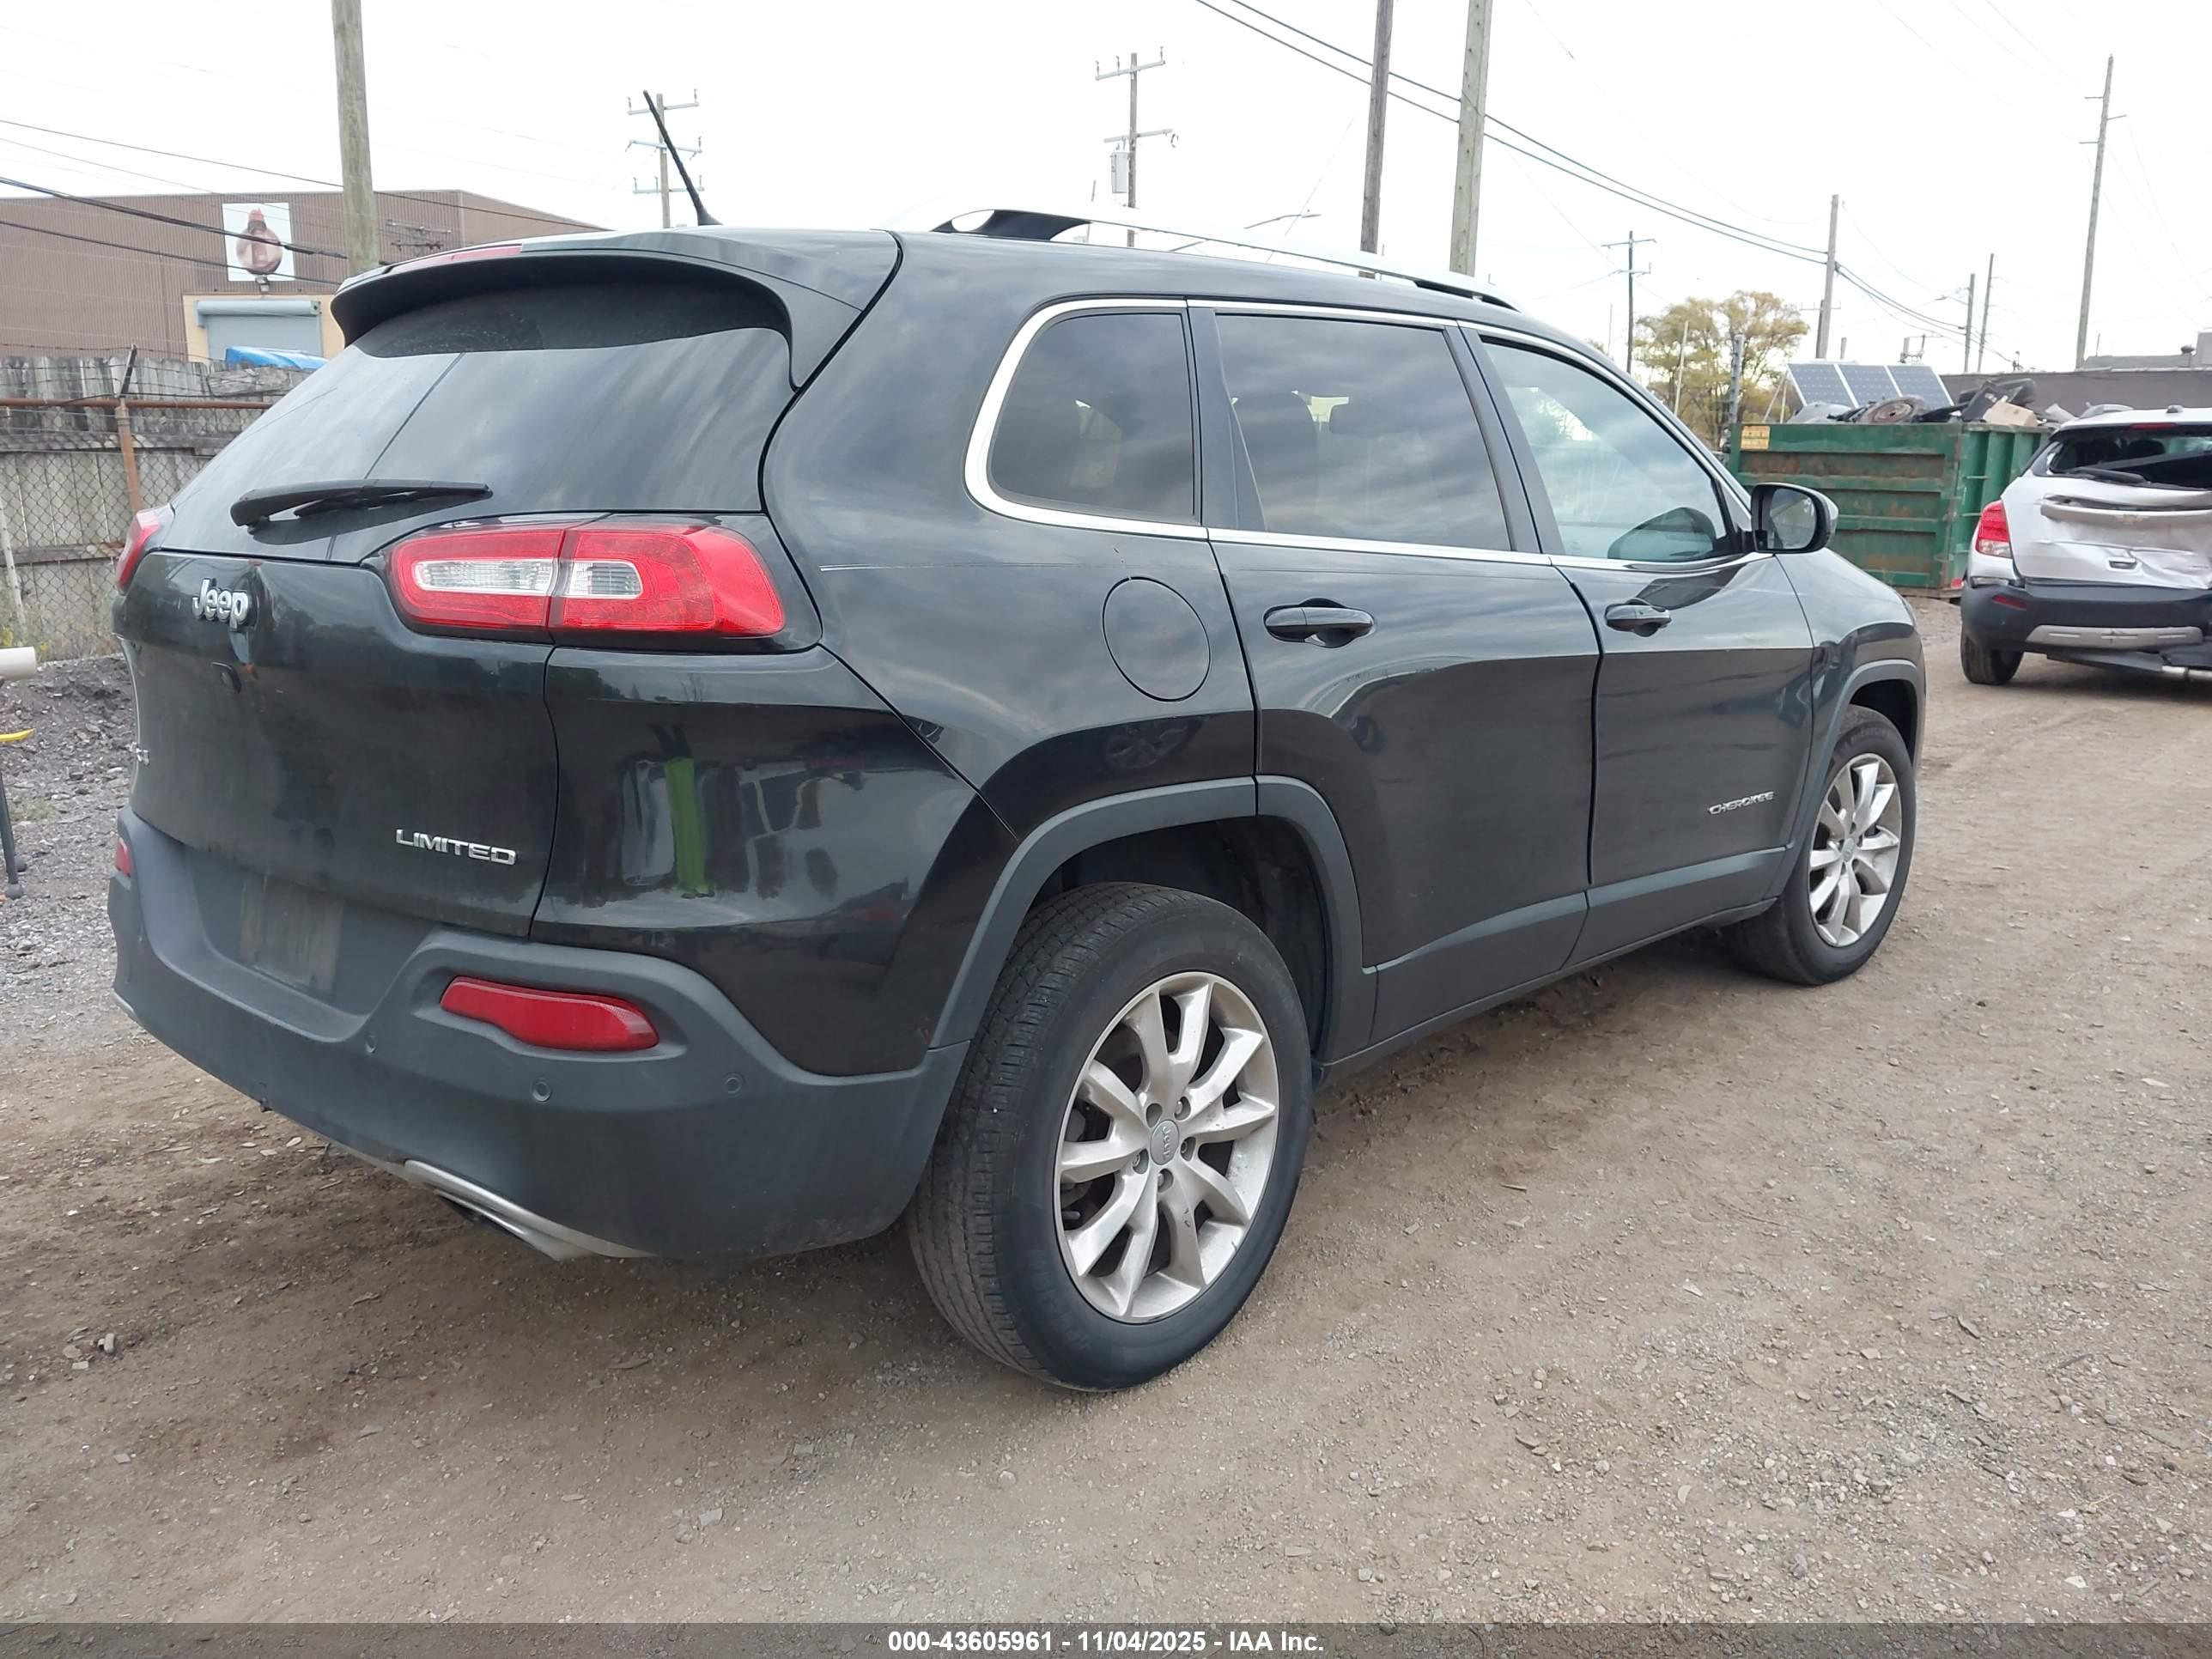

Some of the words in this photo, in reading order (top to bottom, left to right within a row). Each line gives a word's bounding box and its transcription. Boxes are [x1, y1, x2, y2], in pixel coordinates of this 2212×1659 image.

[191, 578, 249, 629] Jeep
[1708, 791, 1774, 815] CHEROKEE
[396, 829, 516, 866] LIMITED
